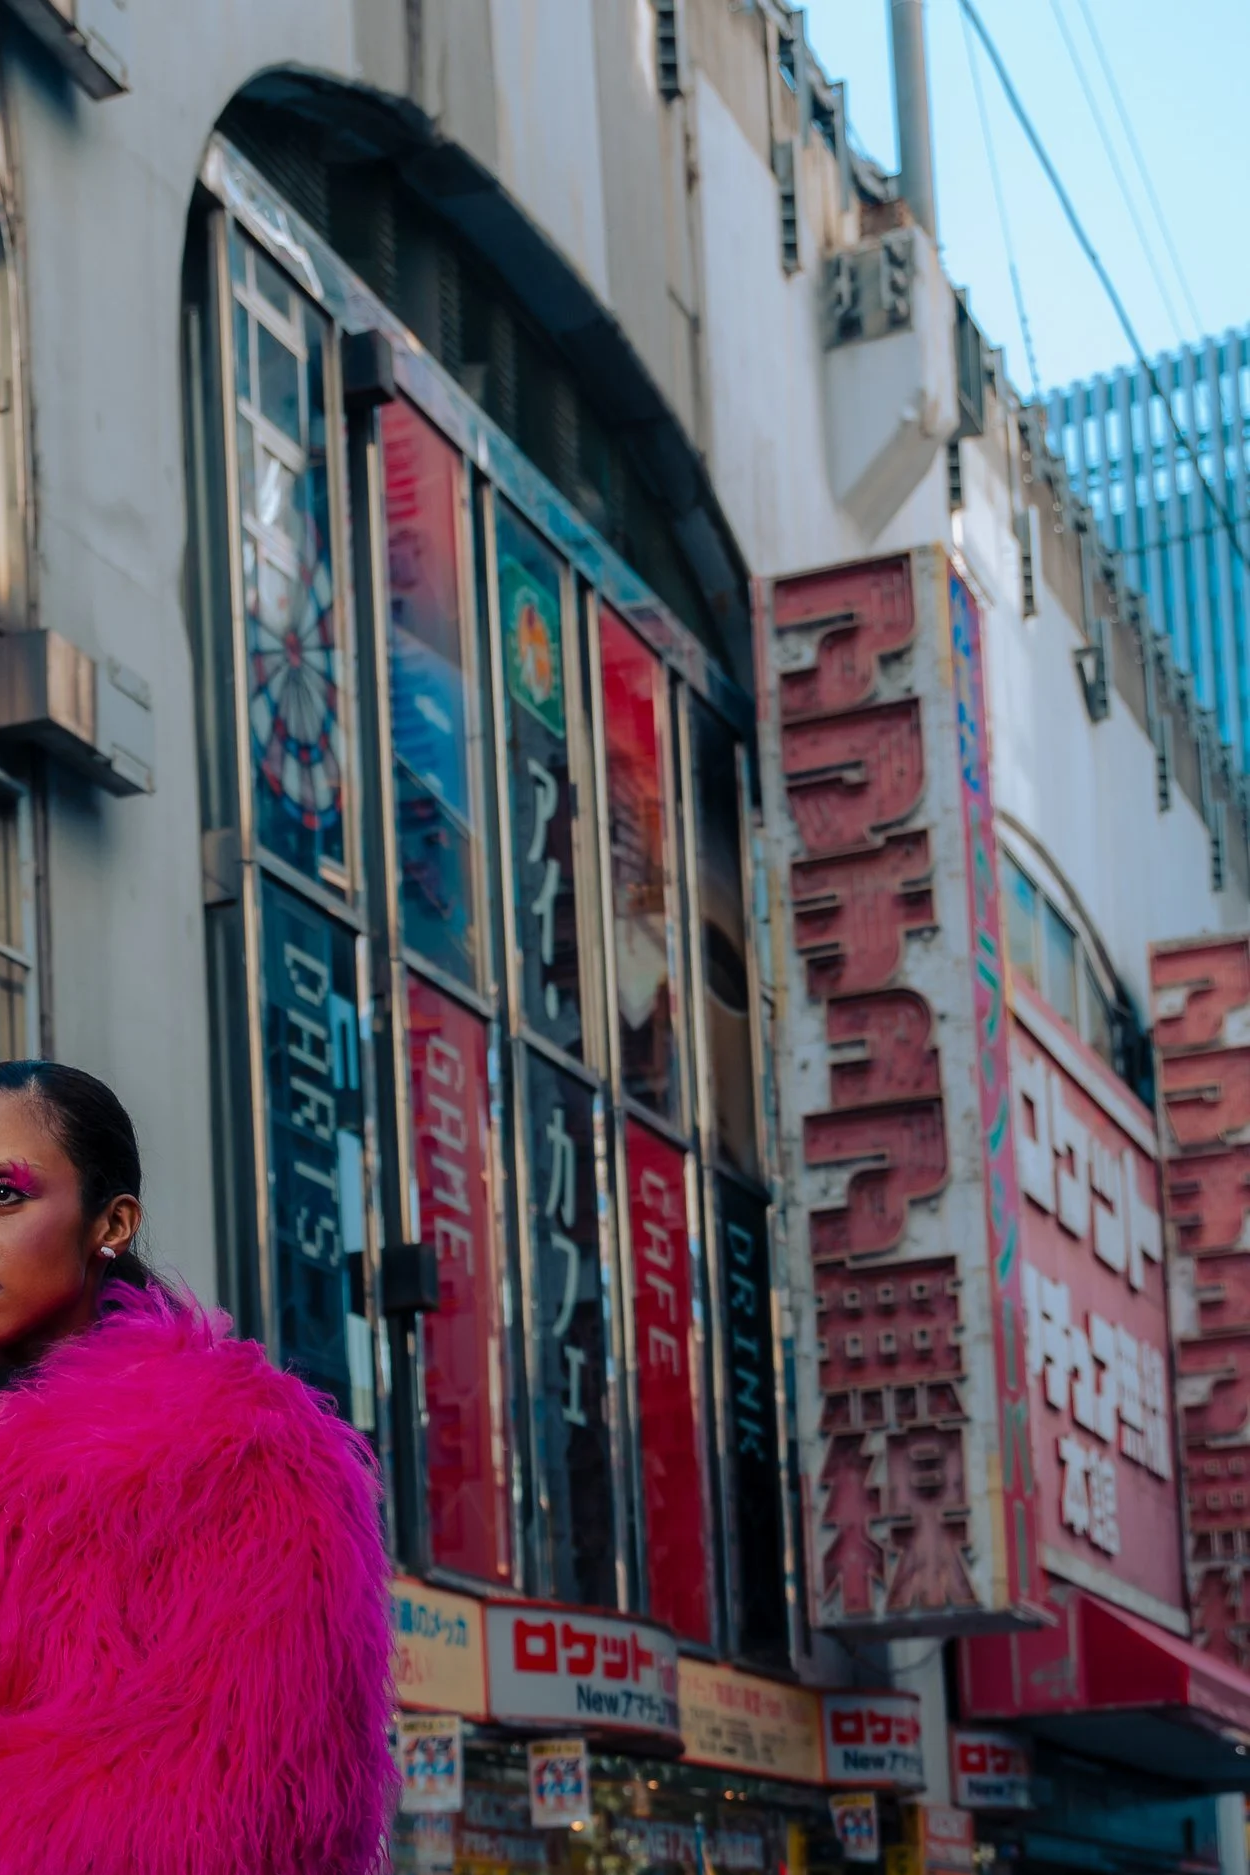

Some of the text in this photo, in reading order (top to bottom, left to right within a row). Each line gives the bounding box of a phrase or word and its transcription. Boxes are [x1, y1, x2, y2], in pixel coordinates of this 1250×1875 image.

[283, 942, 342, 1268] DARTS
[426, 1033, 476, 1279] GAME
[774, 553, 979, 1613] アマチュア無線
[1011, 1052, 1163, 1291] ロケット
[639, 1167, 682, 1378] CAFE
[727, 1221, 768, 1464] DRINK
[514, 1616, 654, 1684] ロケット
